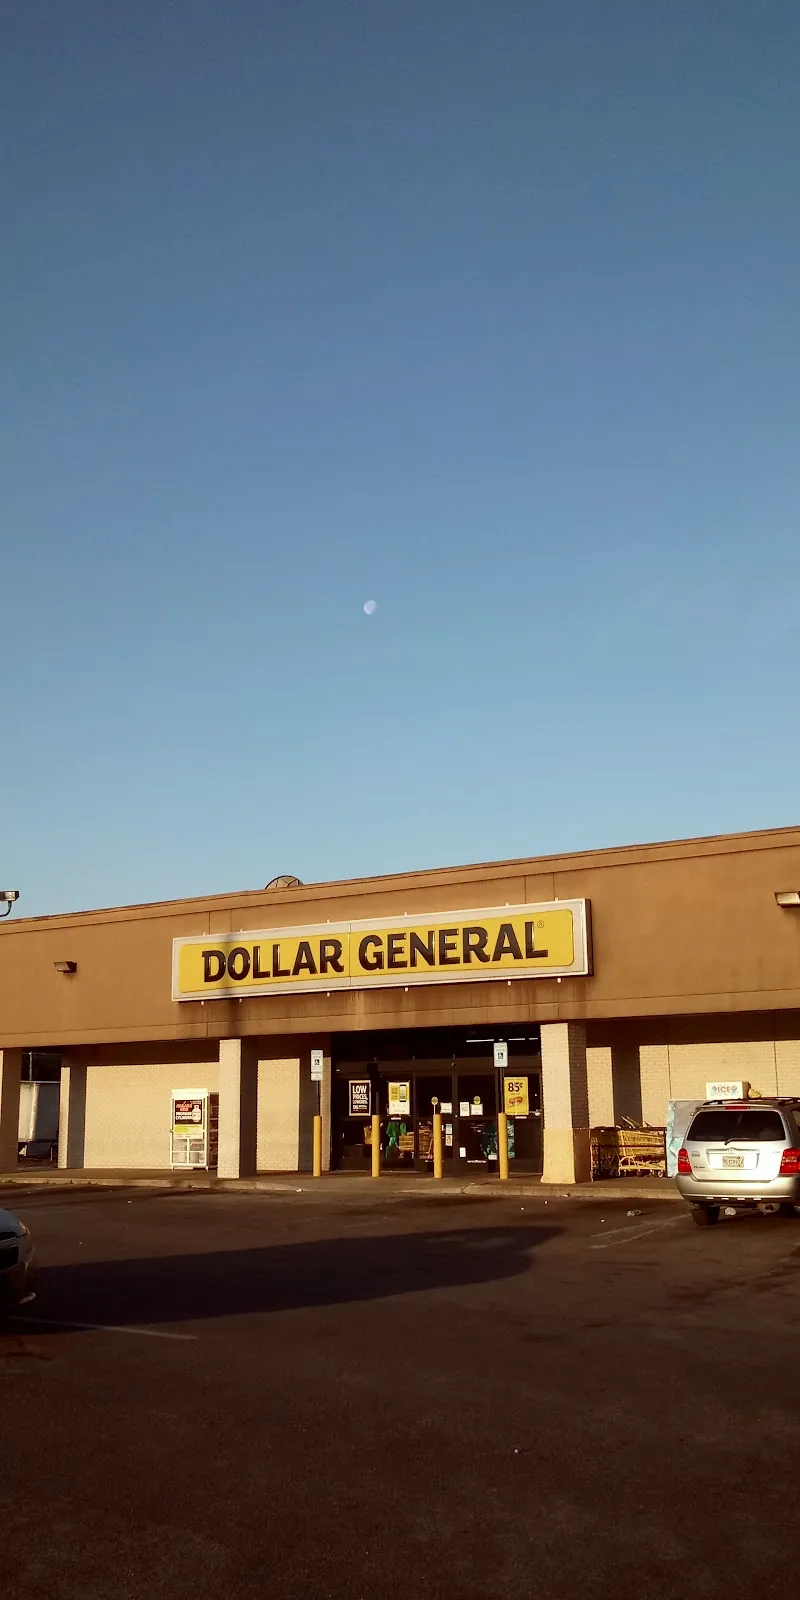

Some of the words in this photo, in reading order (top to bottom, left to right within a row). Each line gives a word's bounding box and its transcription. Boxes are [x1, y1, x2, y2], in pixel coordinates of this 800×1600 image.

[202, 938, 344, 983] DOLLAR
[358, 921, 549, 971] GENERAL
[352, 1085, 367, 1093] LOW
